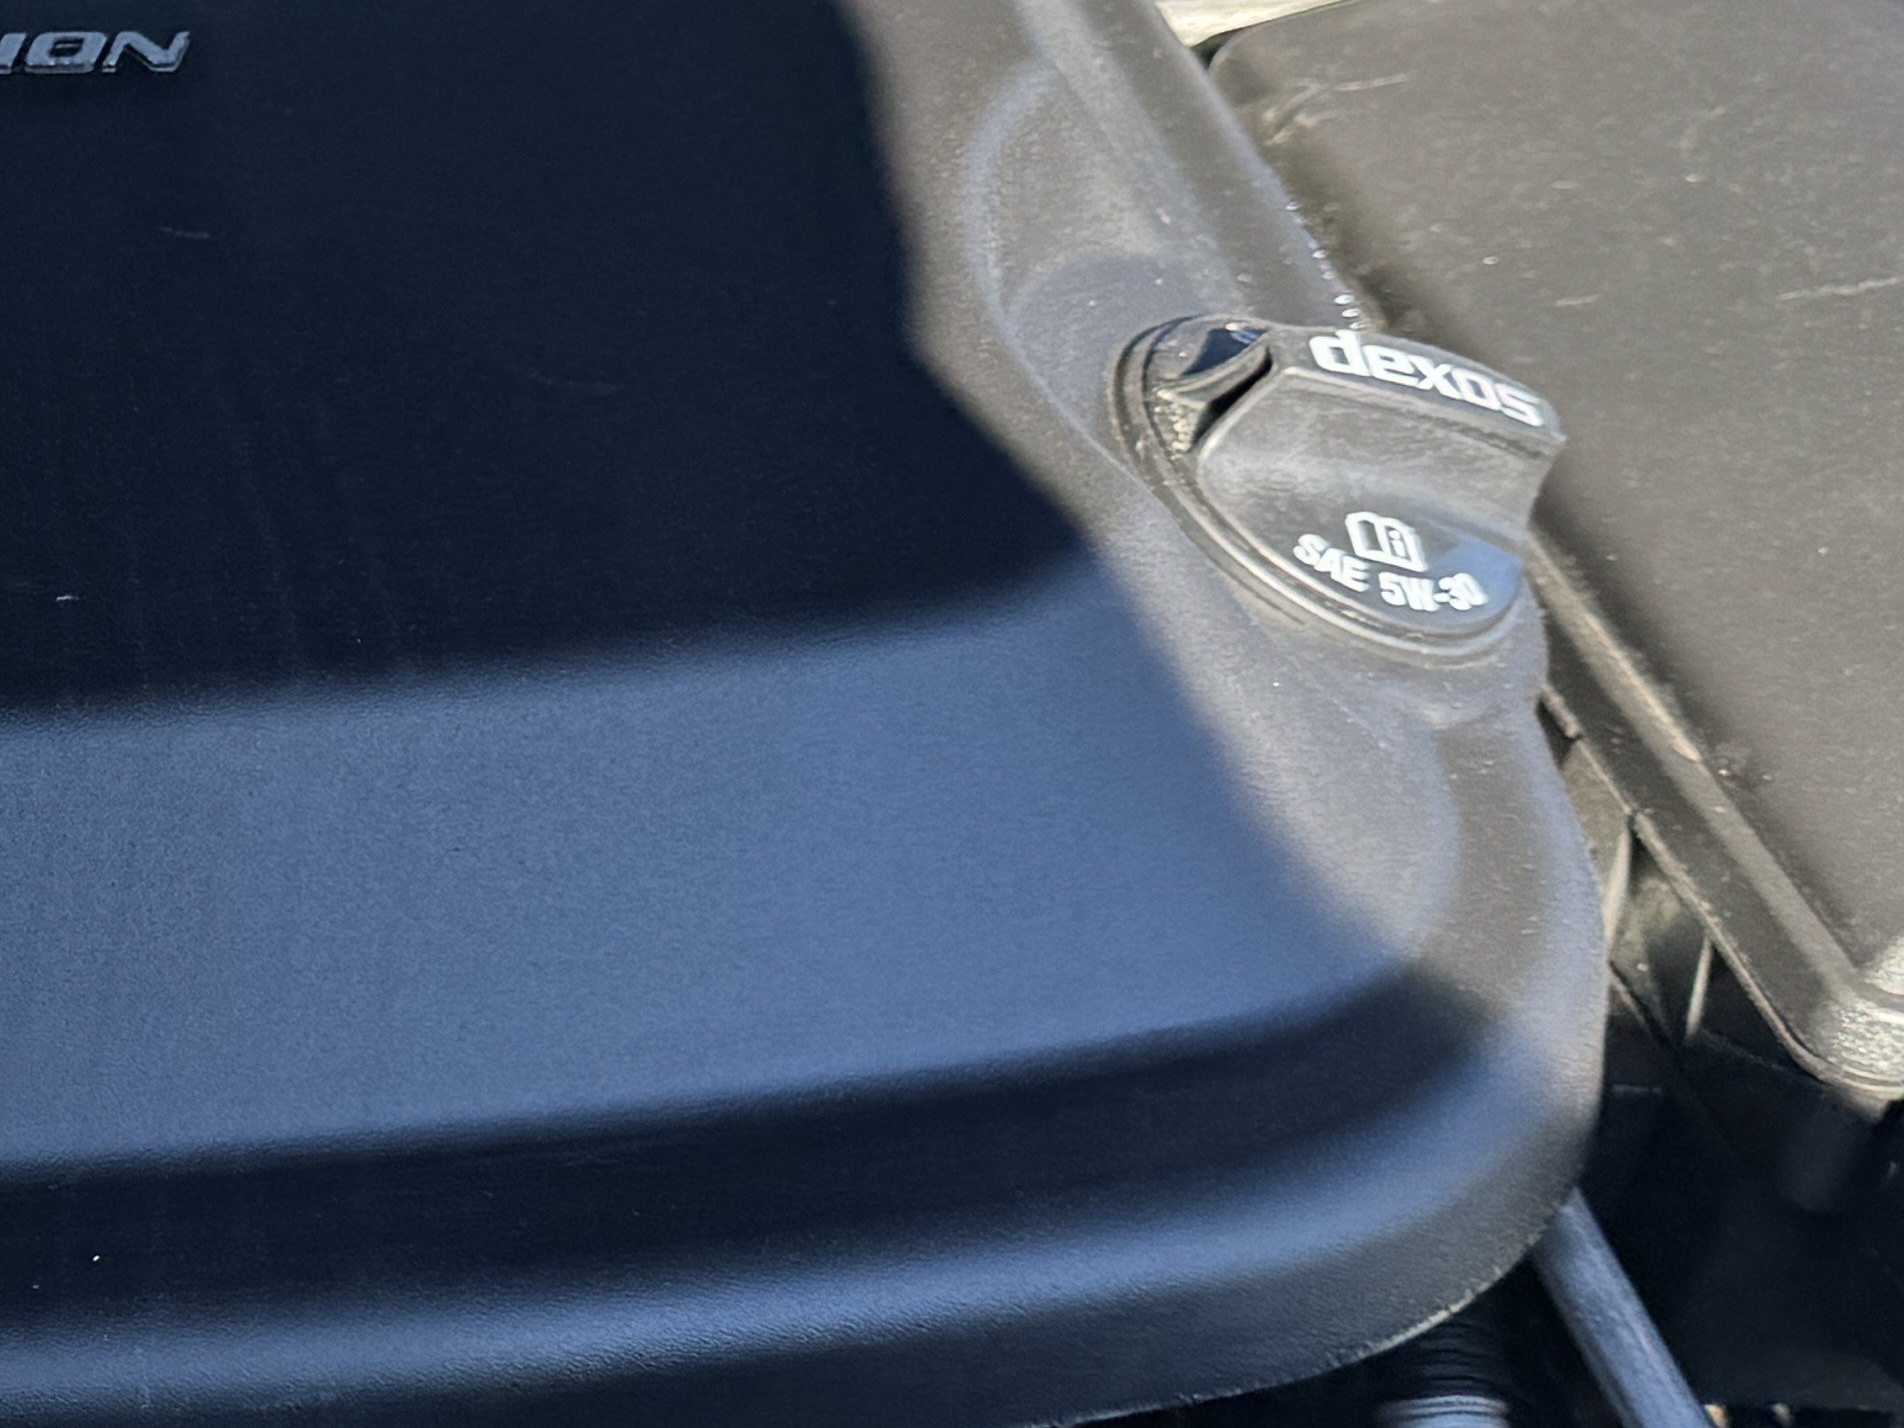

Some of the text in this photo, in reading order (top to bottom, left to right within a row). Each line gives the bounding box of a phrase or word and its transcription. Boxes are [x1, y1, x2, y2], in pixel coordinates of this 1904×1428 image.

[1308, 328, 1544, 428] dexos
[1293, 533, 1489, 613] SAE 5W-30
